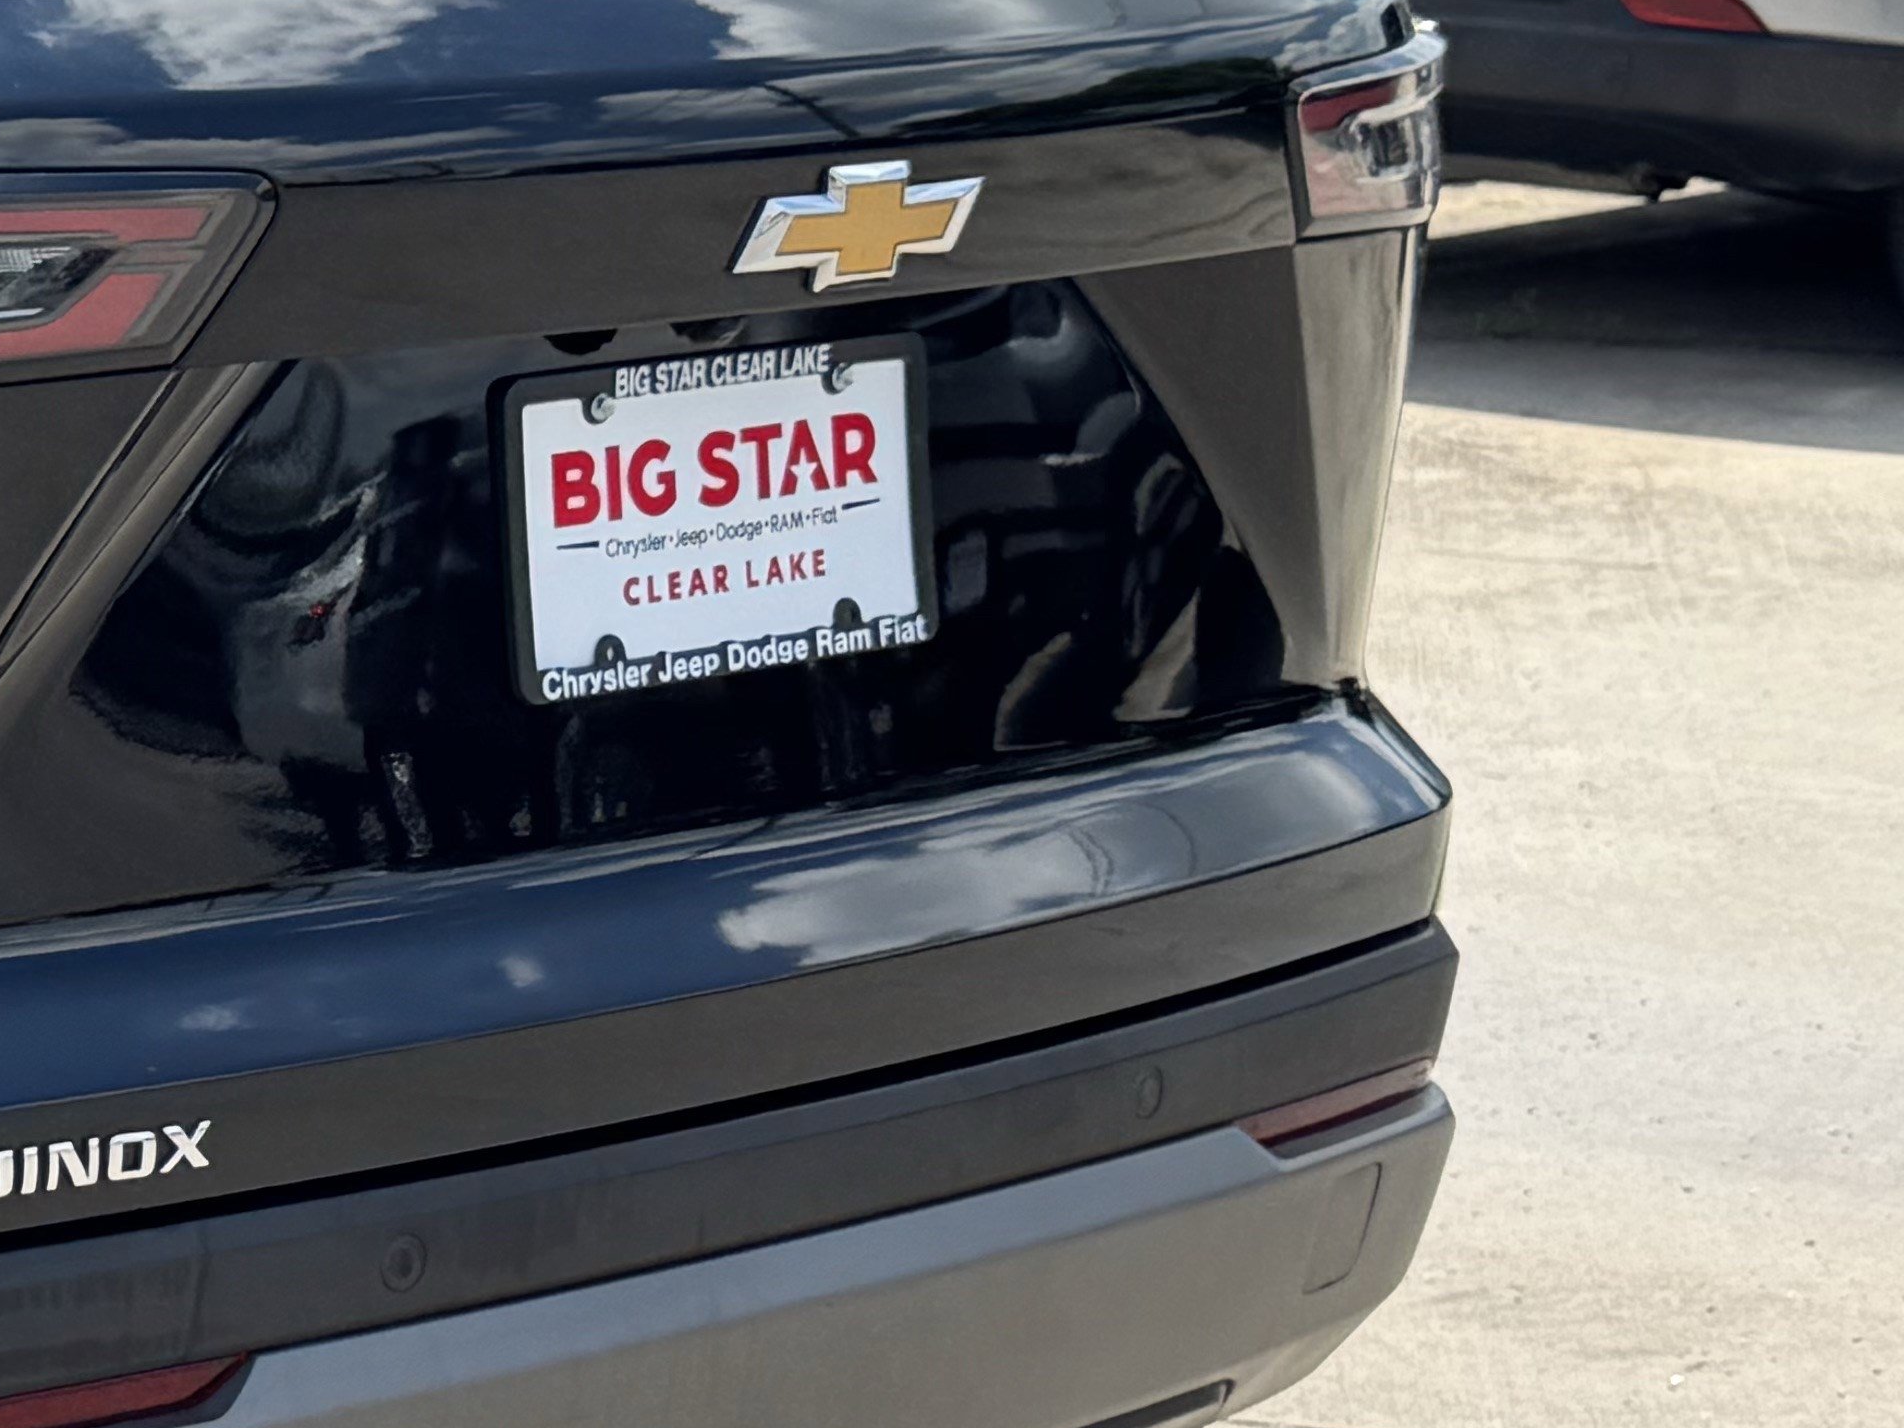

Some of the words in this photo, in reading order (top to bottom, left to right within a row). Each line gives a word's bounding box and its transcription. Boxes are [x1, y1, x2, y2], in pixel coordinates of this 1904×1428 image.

[614, 363, 652, 399] BIG
[655, 358, 707, 393] STAR
[711, 349, 775, 386] CLEAR
[780, 343, 831, 378] LAKE
[550, 438, 678, 529] BIG
[696, 412, 879, 508] STAR
[604, 531, 667, 559] Chrysler
[675, 525, 708, 550] Jeep
[715, 518, 764, 543] Dodge
[769, 512, 804, 534] RAM
[810, 505, 838, 526] Fiat
[622, 563, 731, 607] CLEAR
[745, 548, 827, 589] LAKE
[541, 660, 653, 702] Chrysler
[657, 650, 720, 684] Jeep
[726, 637, 809, 673] Dodge
[815, 627, 872, 659] Ram
[878, 613, 930, 648] Fiat
